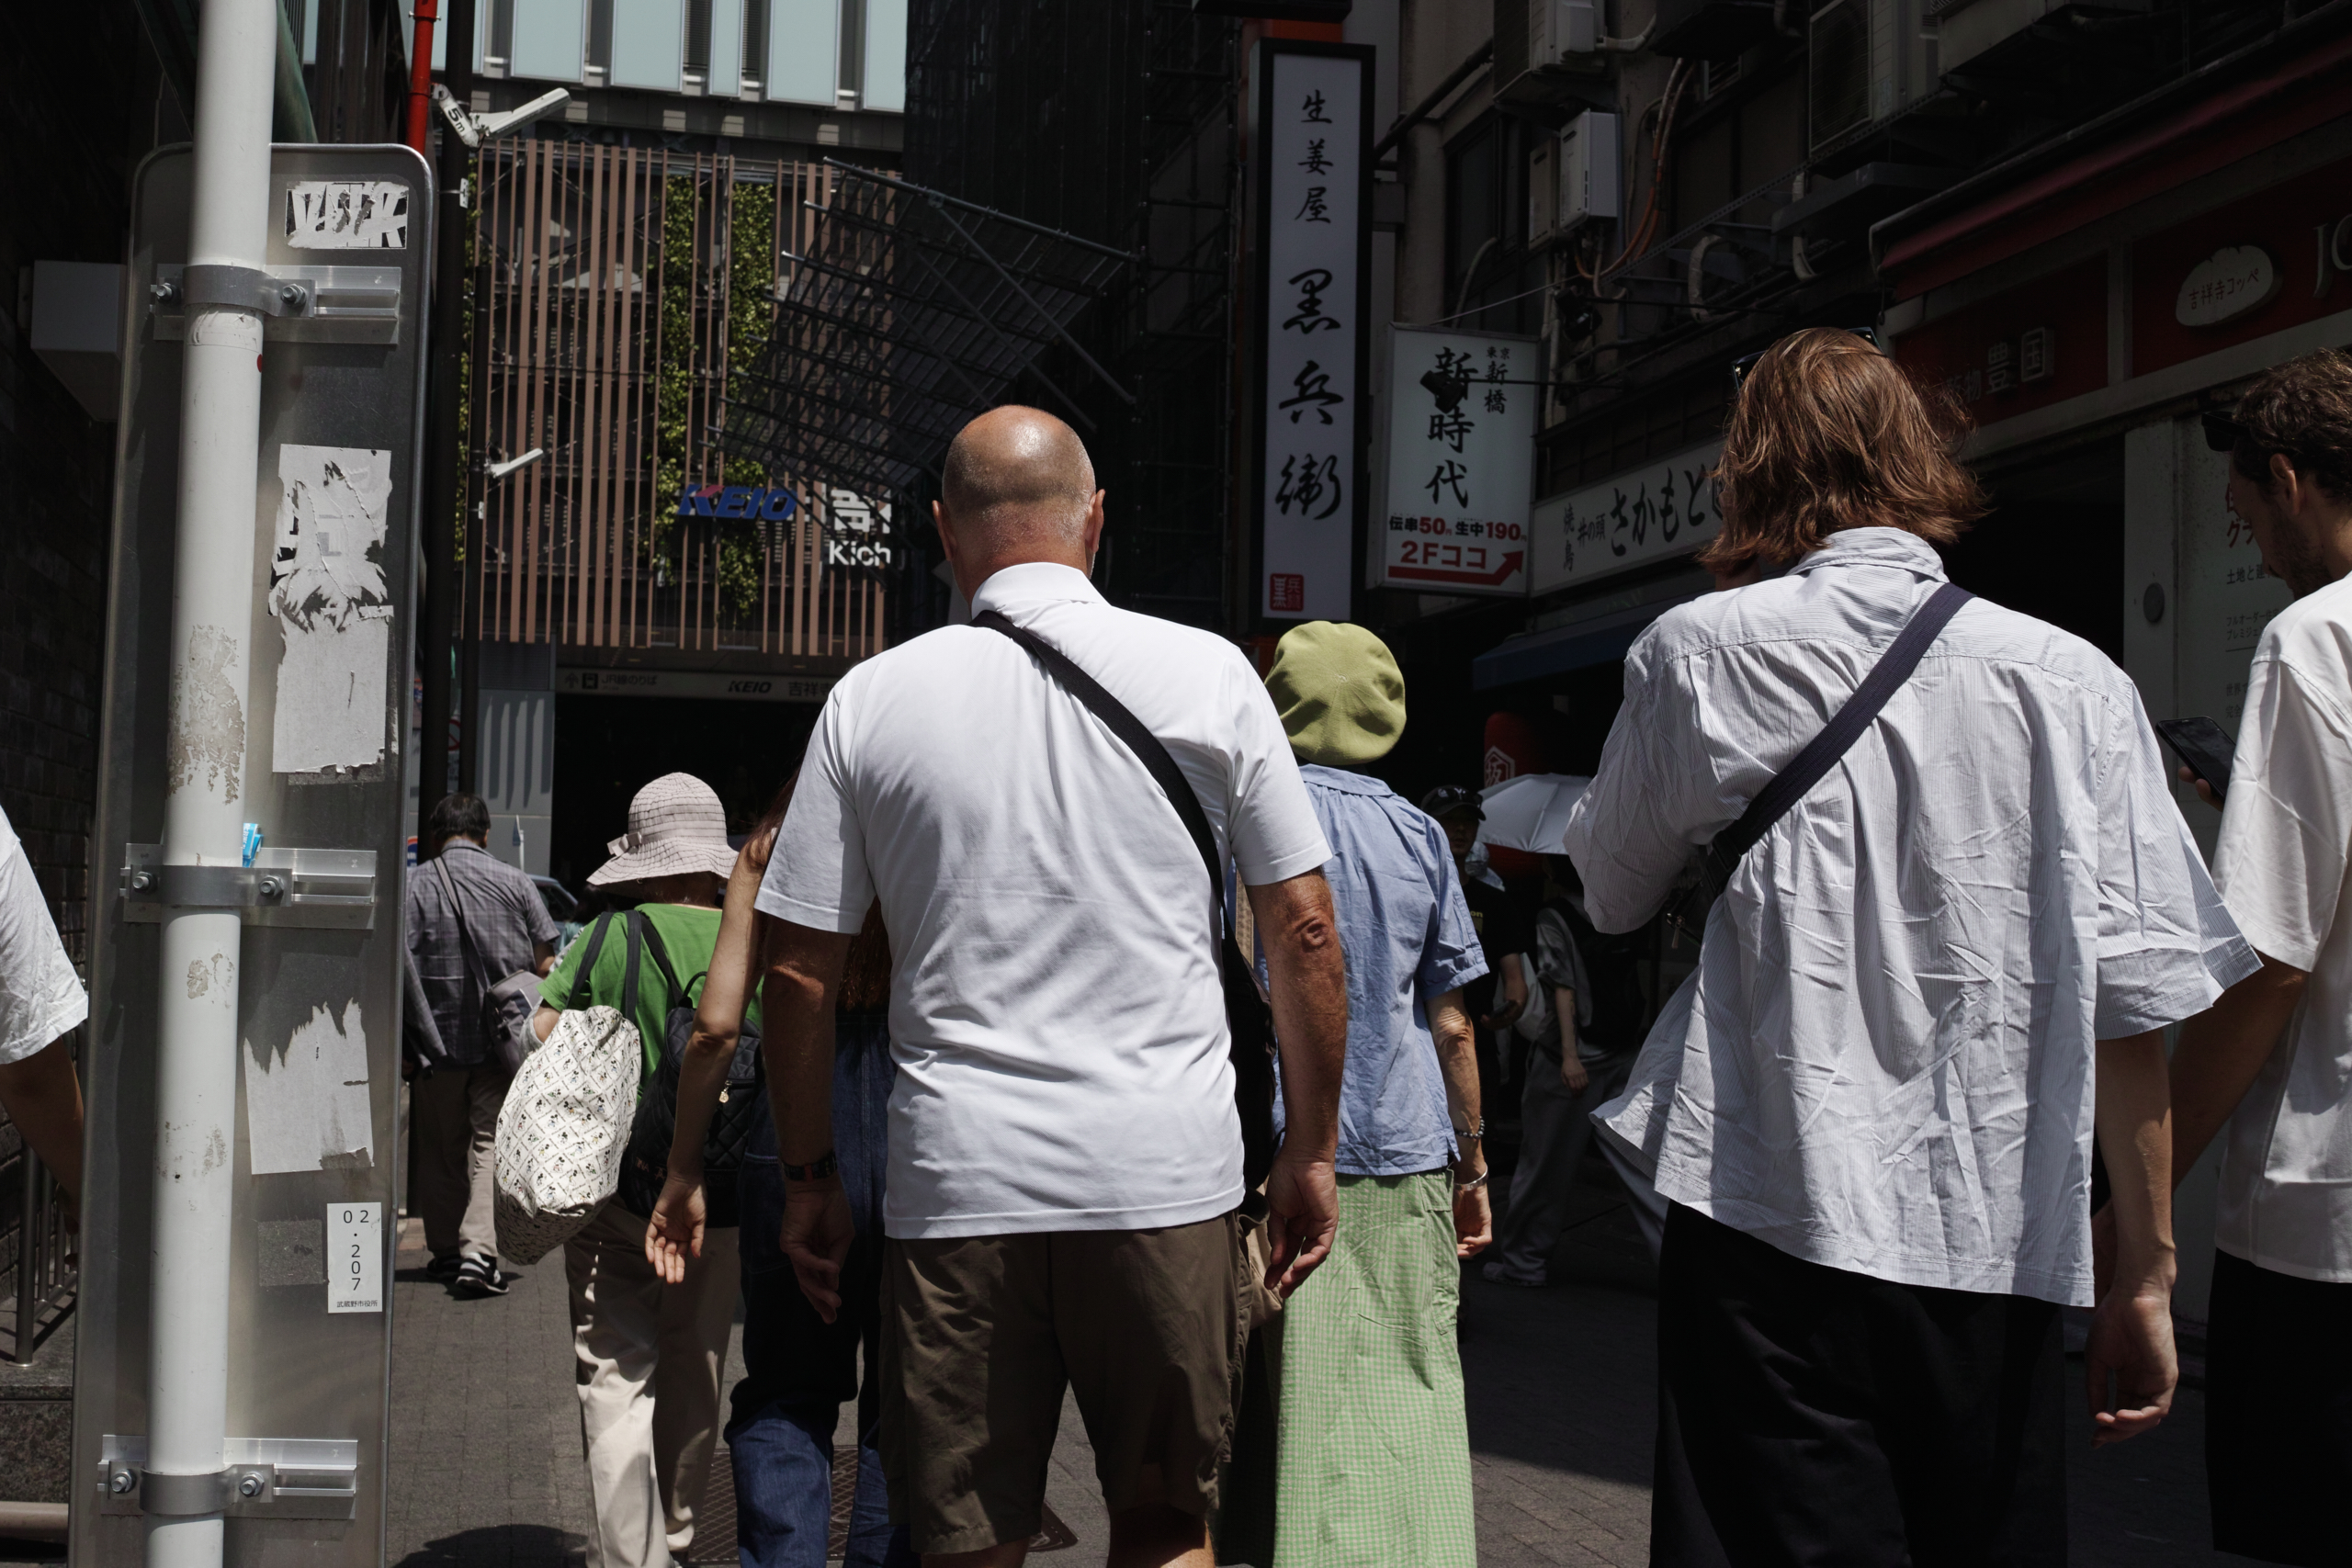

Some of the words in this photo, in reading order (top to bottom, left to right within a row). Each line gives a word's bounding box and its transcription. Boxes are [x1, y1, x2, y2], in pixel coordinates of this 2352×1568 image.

[447, 107, 466, 133] 5m
[1295, 89, 1334, 224] 生姜屋
[2188, 267, 2259, 310] 吉祥寺コッペ
[1487, 346, 1510, 360] 東京
[1985, 326, 2047, 396] 豊国
[1484, 360, 1509, 414] 新橋
[677, 483, 798, 521] KEIO
[1577, 513, 1606, 548] 井の頭
[1610, 463, 1706, 557] さかもと
[1564, 502, 1575, 572] 焼鳥
[2226, 564, 2271, 585] 土地と建
[2226, 626, 2263, 641] プレミジェ
[729, 680, 772, 694] KEIO
